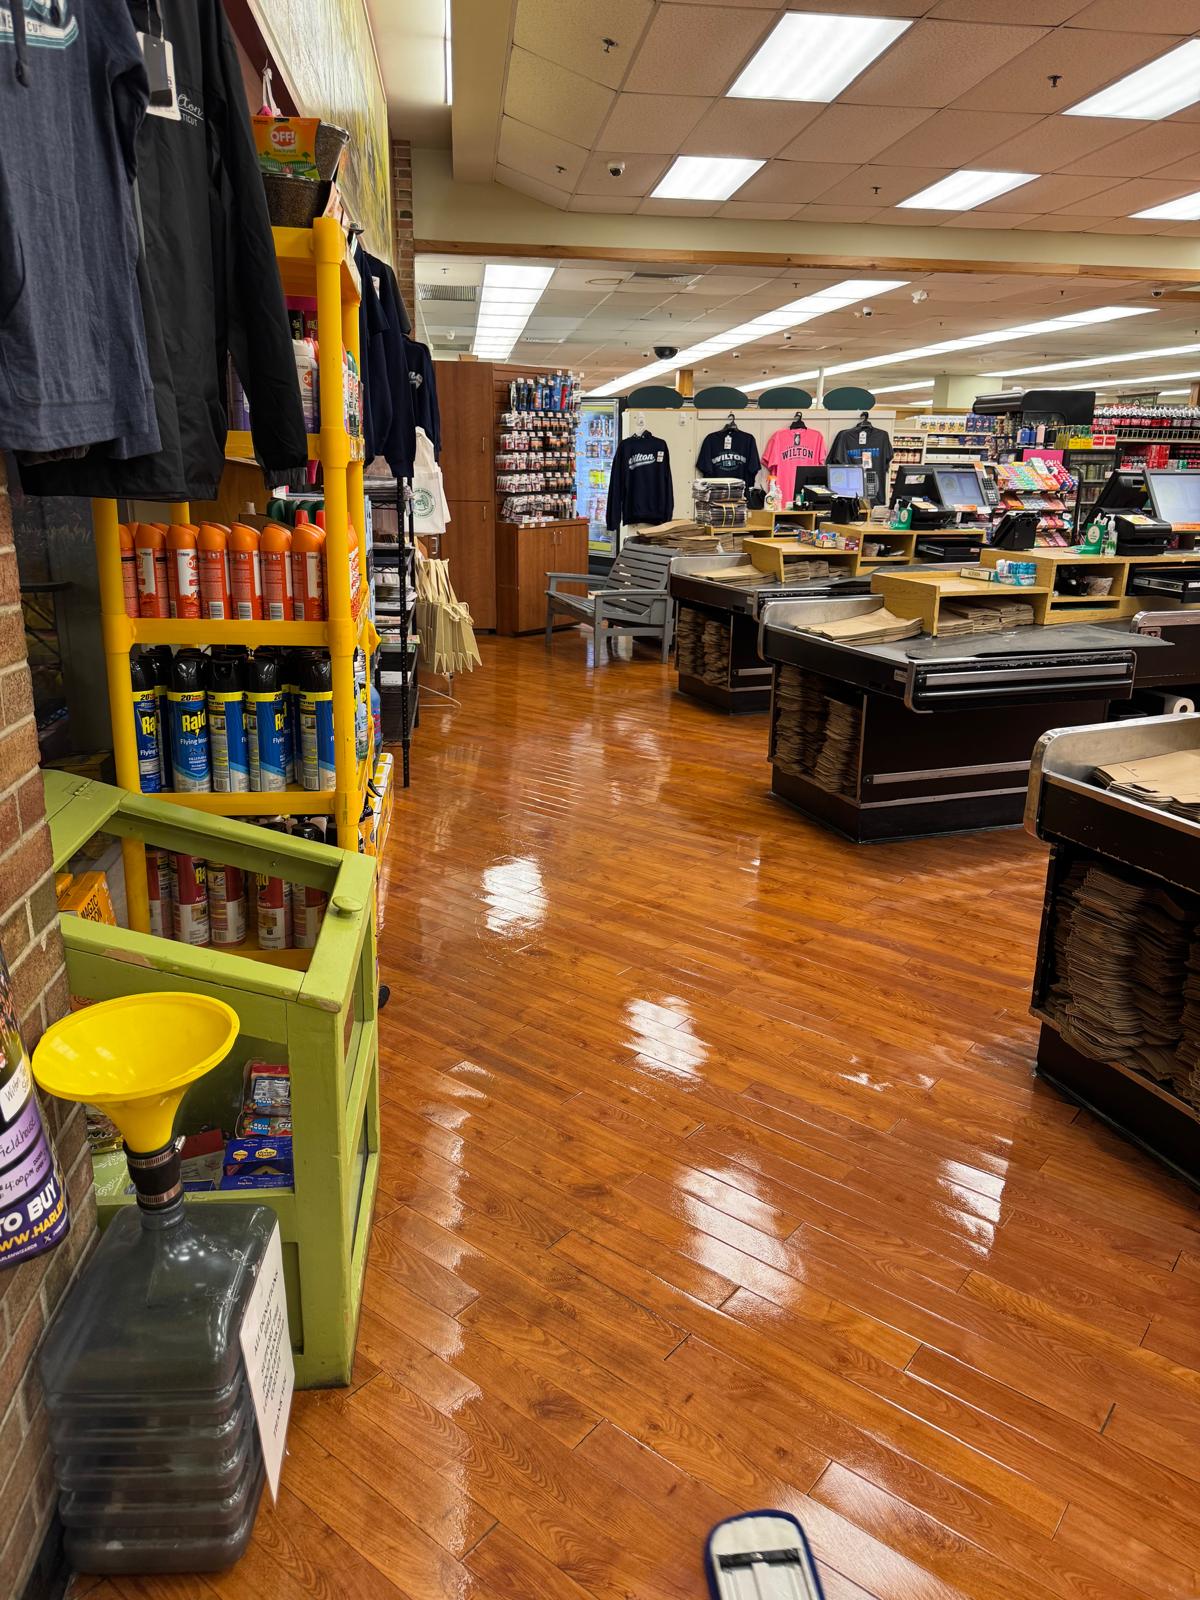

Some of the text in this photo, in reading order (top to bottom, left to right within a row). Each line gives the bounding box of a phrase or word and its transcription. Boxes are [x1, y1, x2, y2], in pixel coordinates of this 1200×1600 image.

[271, 131, 294, 144] OFF!
[711, 453, 746, 464] WILTON
[782, 447, 814, 460] WILTON
[182, 711, 206, 732] Raid
[180, 738, 199, 746] Flying
[27, 1177, 57, 1222] BUY
